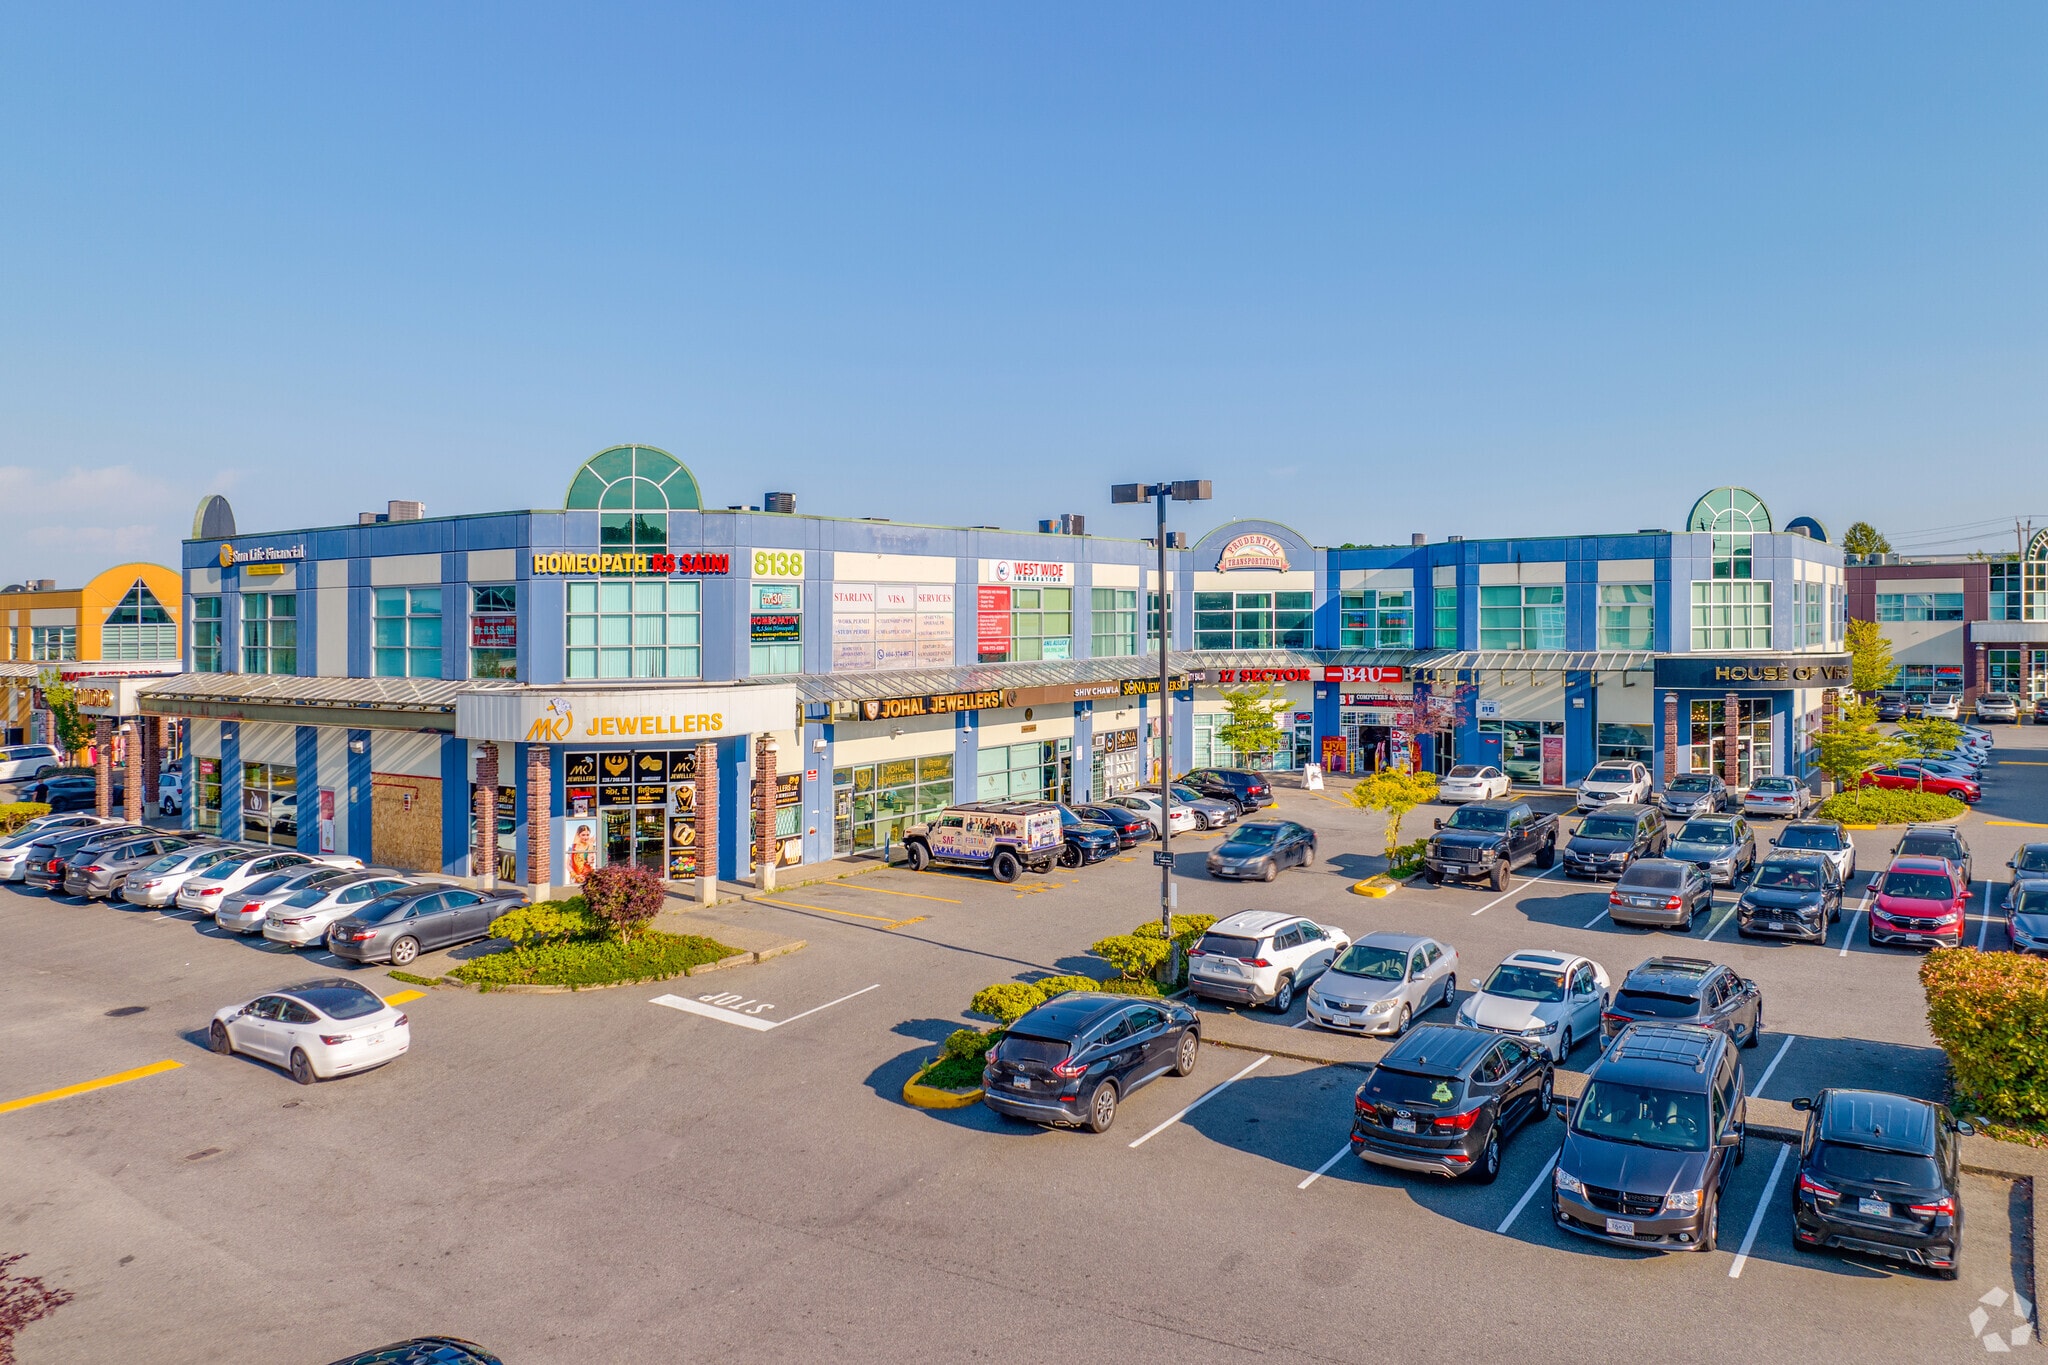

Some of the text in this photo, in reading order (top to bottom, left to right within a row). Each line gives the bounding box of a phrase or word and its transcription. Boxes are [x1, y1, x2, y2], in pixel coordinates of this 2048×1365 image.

[1228, 535, 1280, 554] PRUDENTIAL
[233, 544, 304, 562] Sun Life Financial
[533, 553, 730, 573] HOMEOPATH RS SAINI
[754, 551, 803, 576] 8138
[1013, 562, 1064, 576] WEST WIDE
[1228, 558, 1280, 567] TRANSPORTATION
[834, 592, 873, 602] STARLINX
[887, 594, 905, 603] VISA
[918, 593, 951, 603] SERVICES
[1220, 668, 1311, 682] 17 SECTOR
[1342, 667, 1383, 682] B4U
[1715, 667, 1788, 680] HOUSE
[1794, 666, 1819, 680] OF
[1074, 686, 1119, 697] SHIV CHAWLA
[1123, 680, 1147, 695] SONA
[880, 691, 1000, 718] JOHAL JEWELLERS
[586, 713, 723, 736] JEWELLERS
[670, 772, 696, 780] JEWELLER
[886, 764, 907, 775] JOHAL
[567, 775, 596, 783] JEWELLERS
[942, 835, 954, 845] SAF
[965, 837, 987, 846] FESTIVAL
[698, 992, 775, 1014] STOP
